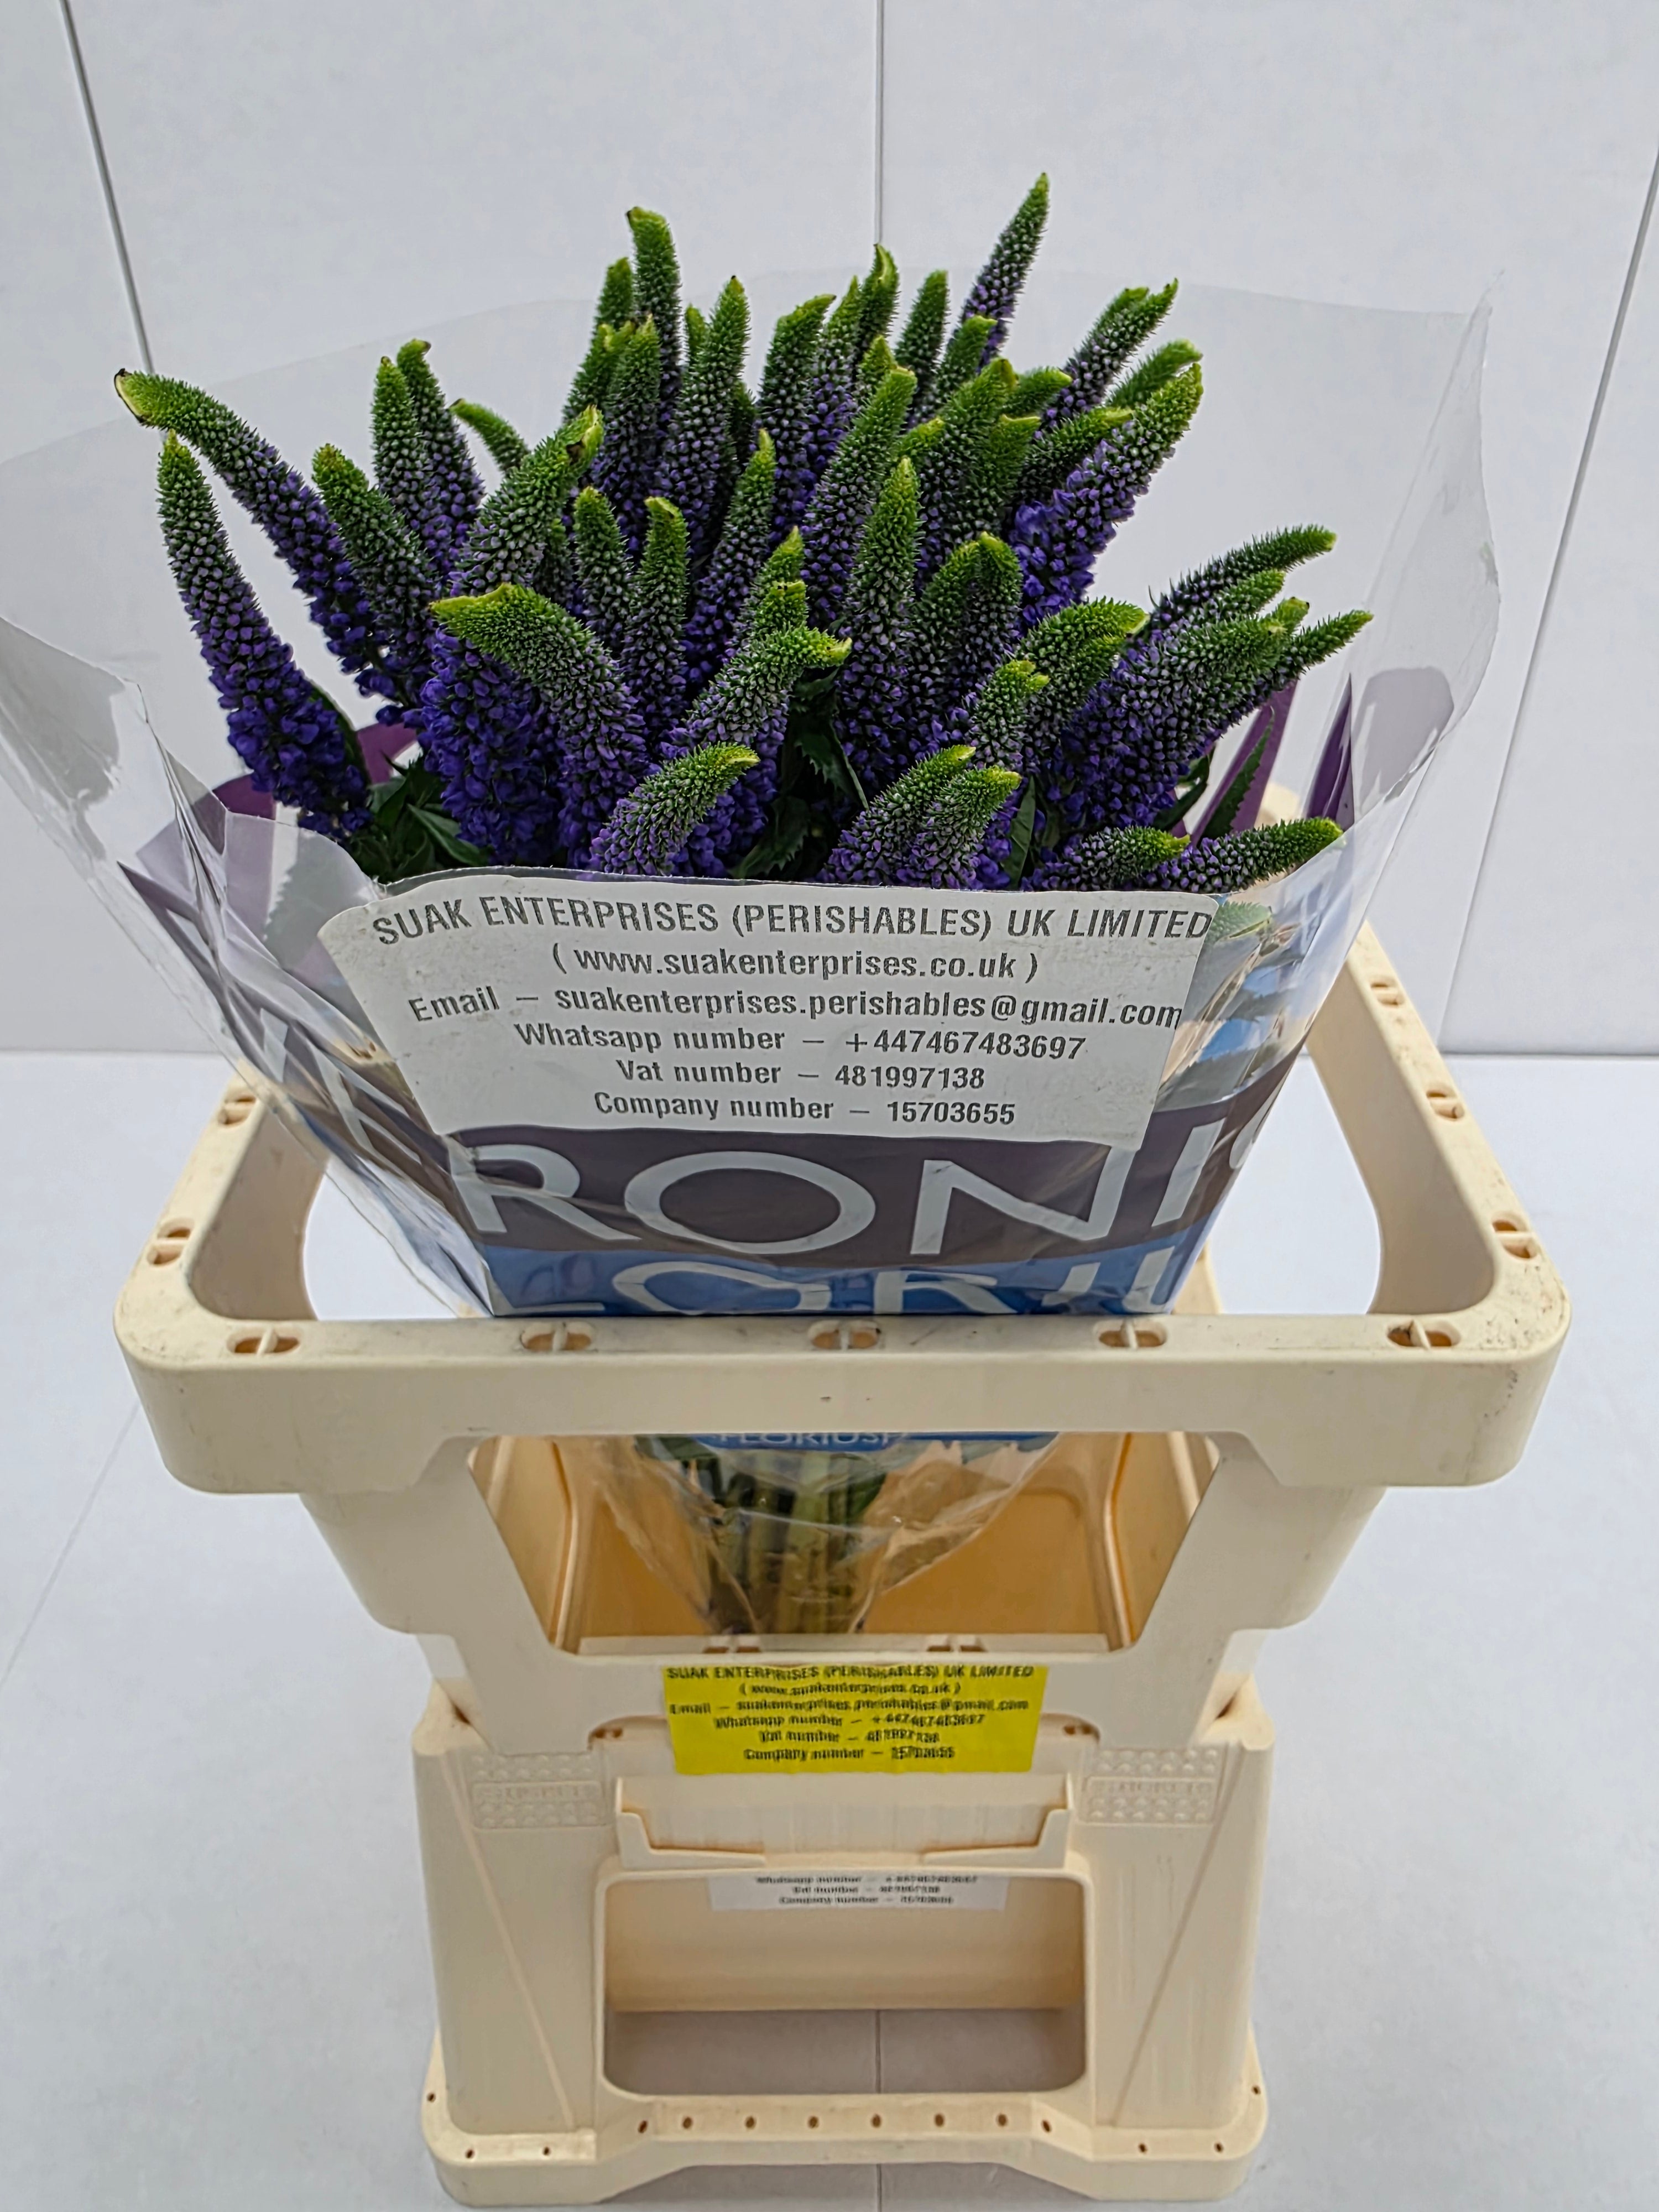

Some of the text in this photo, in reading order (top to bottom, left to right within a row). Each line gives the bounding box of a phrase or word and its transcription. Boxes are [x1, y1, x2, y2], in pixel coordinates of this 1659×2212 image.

[373, 896, 1212, 945] SUAK ENTERPRISES (PERISHABLES) UK LIMITED
[573, 948, 1016, 980] www.suakenterprises.co.uk
[409, 986, 499, 1021] Email
[556, 987, 1182, 1029] suakenterprises.perishables@gmail.com
[514, 1023, 661, 1052] Whatsapp
[674, 1027, 785, 1049] number
[846, 1030, 1086, 1058] +447467483697
[616, 1060, 663, 1081] Vat
[674, 1062, 781, 1083] number
[836, 1065, 984, 1091] 481997138
[594, 1092, 718, 1120] Company
[731, 1097, 833, 1119] number
[888, 1102, 1015, 1125] 15703655
[667, 1667, 708, 1679] SUAK
[714, 1666, 819, 1681] ENTERPRISES
[944, 1665, 964, 1677] UK
